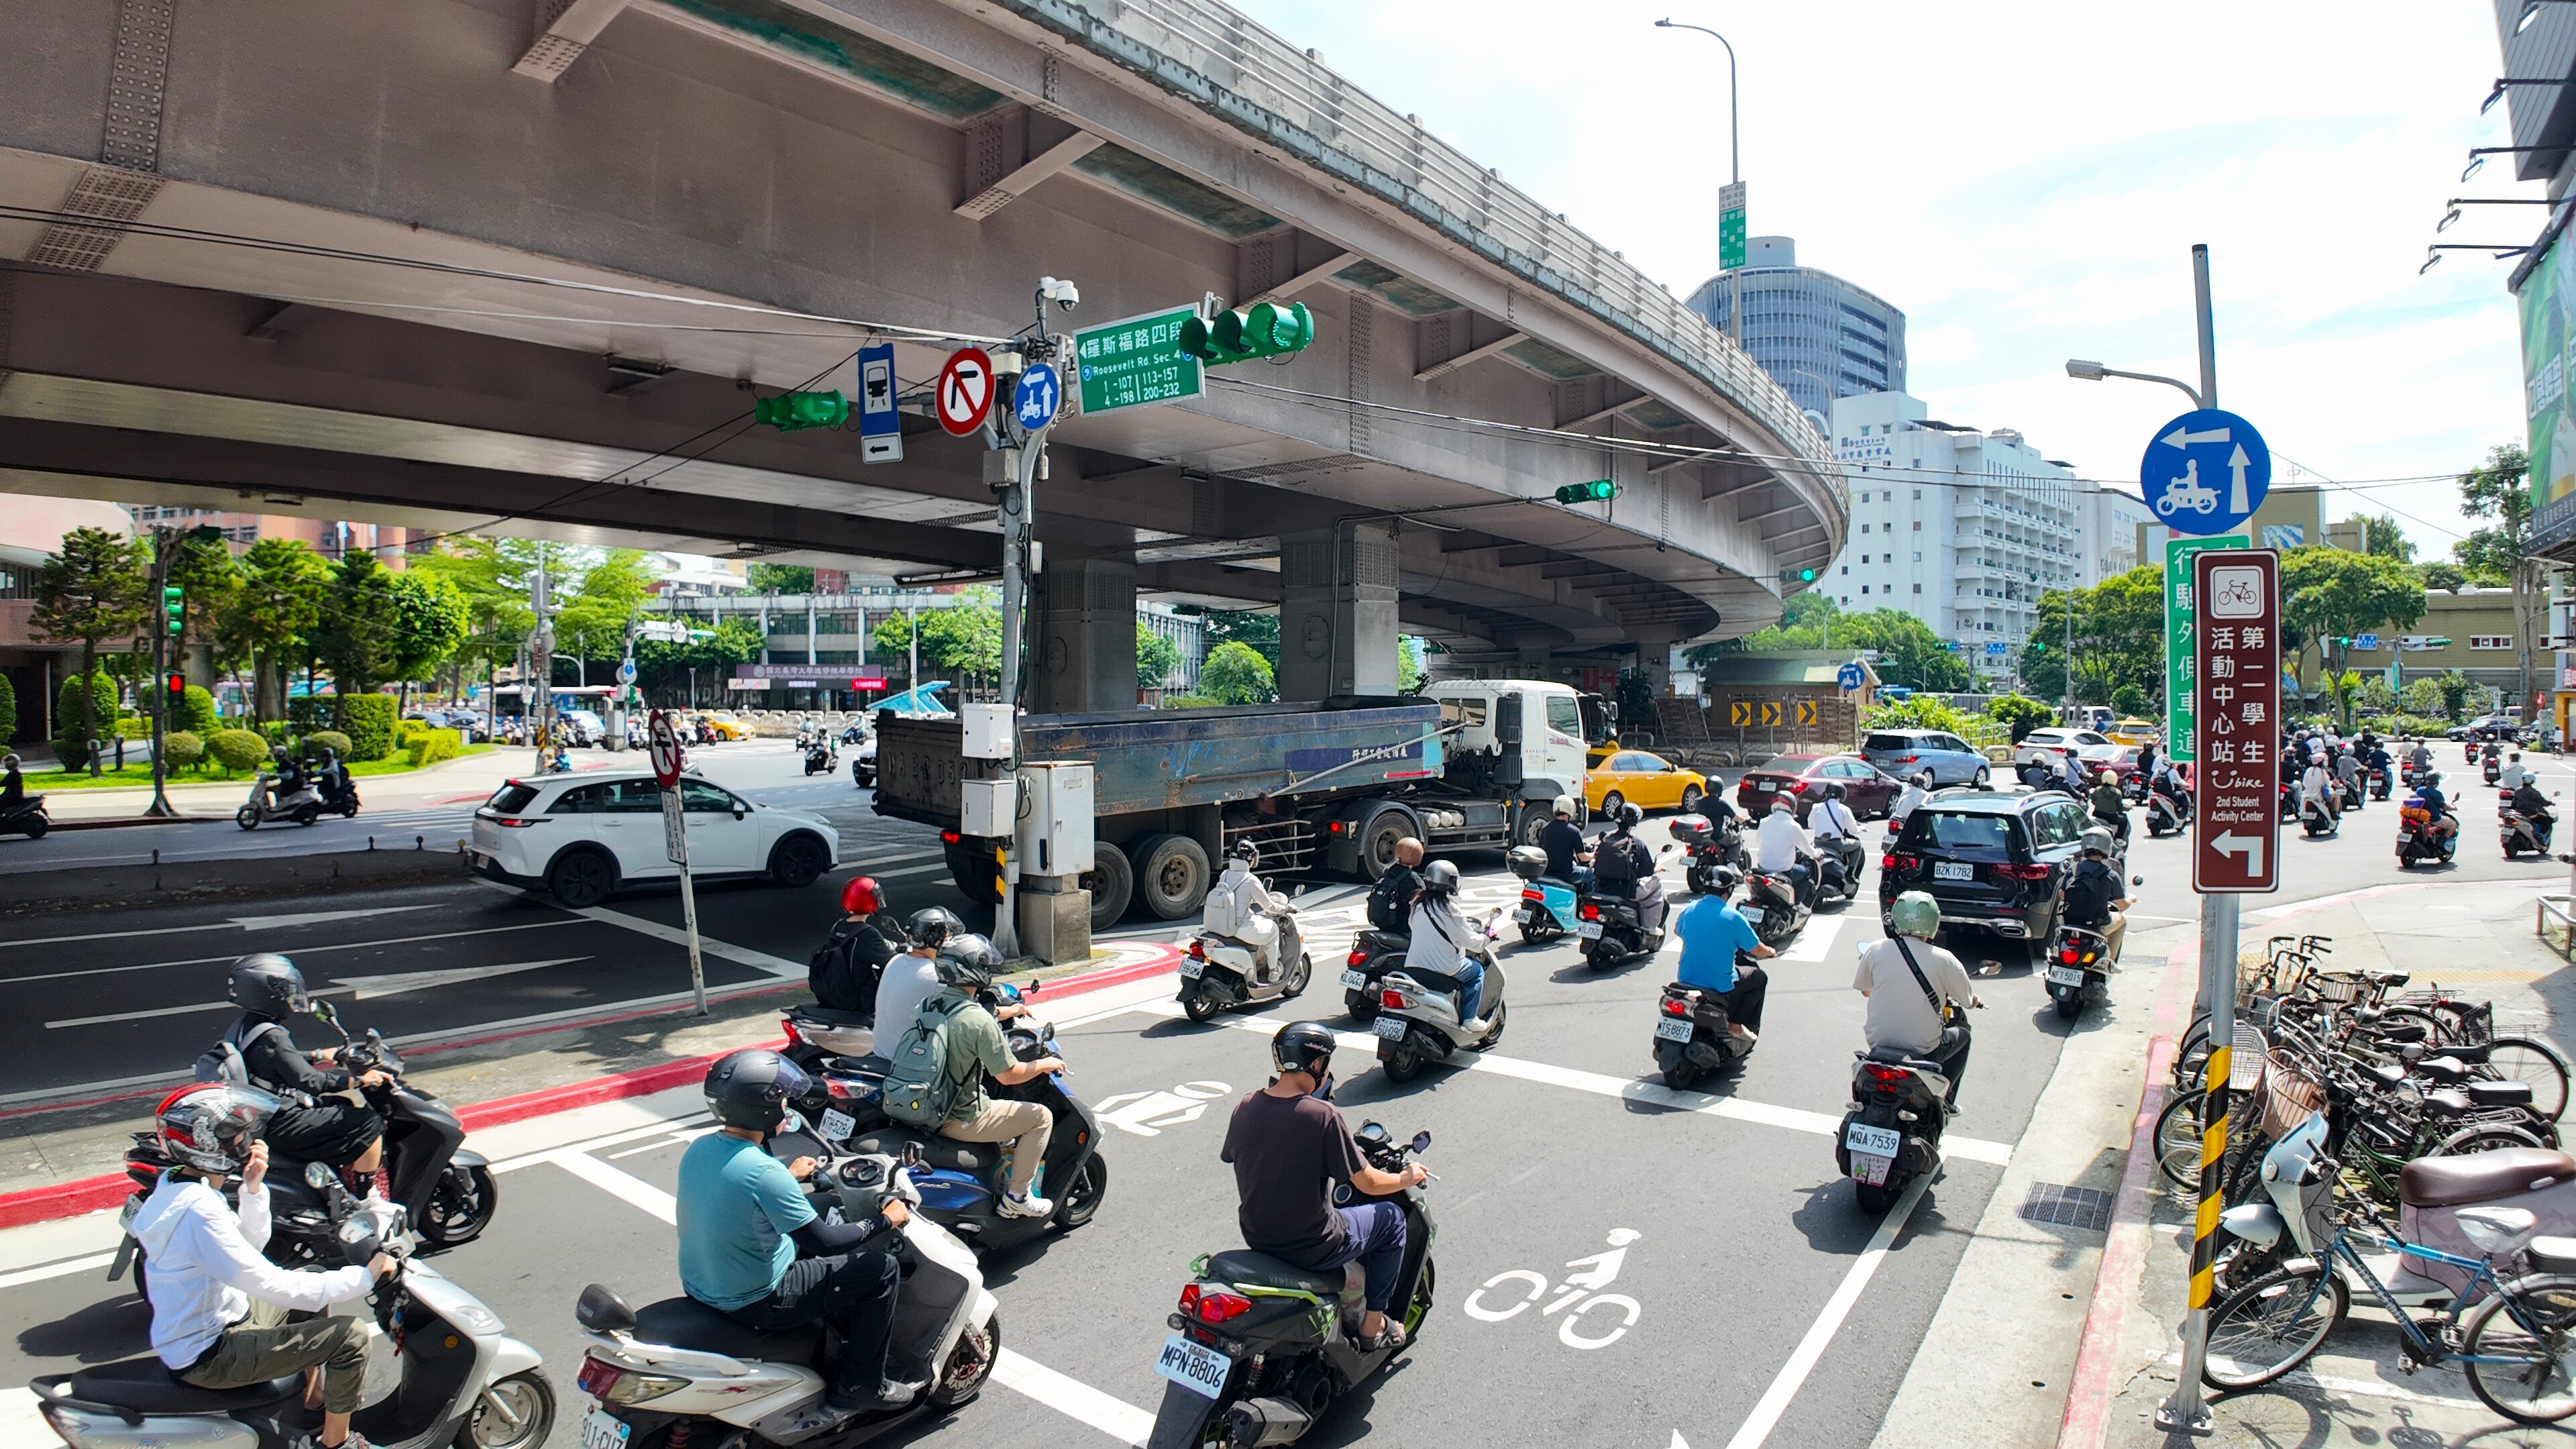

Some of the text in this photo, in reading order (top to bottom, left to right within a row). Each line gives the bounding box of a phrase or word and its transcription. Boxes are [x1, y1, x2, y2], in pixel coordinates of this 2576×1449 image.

[1087, 321, 1183, 358] 羅斯福路四段
[1093, 350, 1181, 376] Roosevelt Rd. Sec. 4
[1143, 366, 1178, 385] 113-157
[1143, 382, 1180, 400] 200-232
[2211, 627, 2235, 763] 活動中心站
[2241, 627, 2265, 763] 第二學生
[2216, 796, 2260, 808] 2nd Student
[2211, 810, 2265, 824] Activity Center
